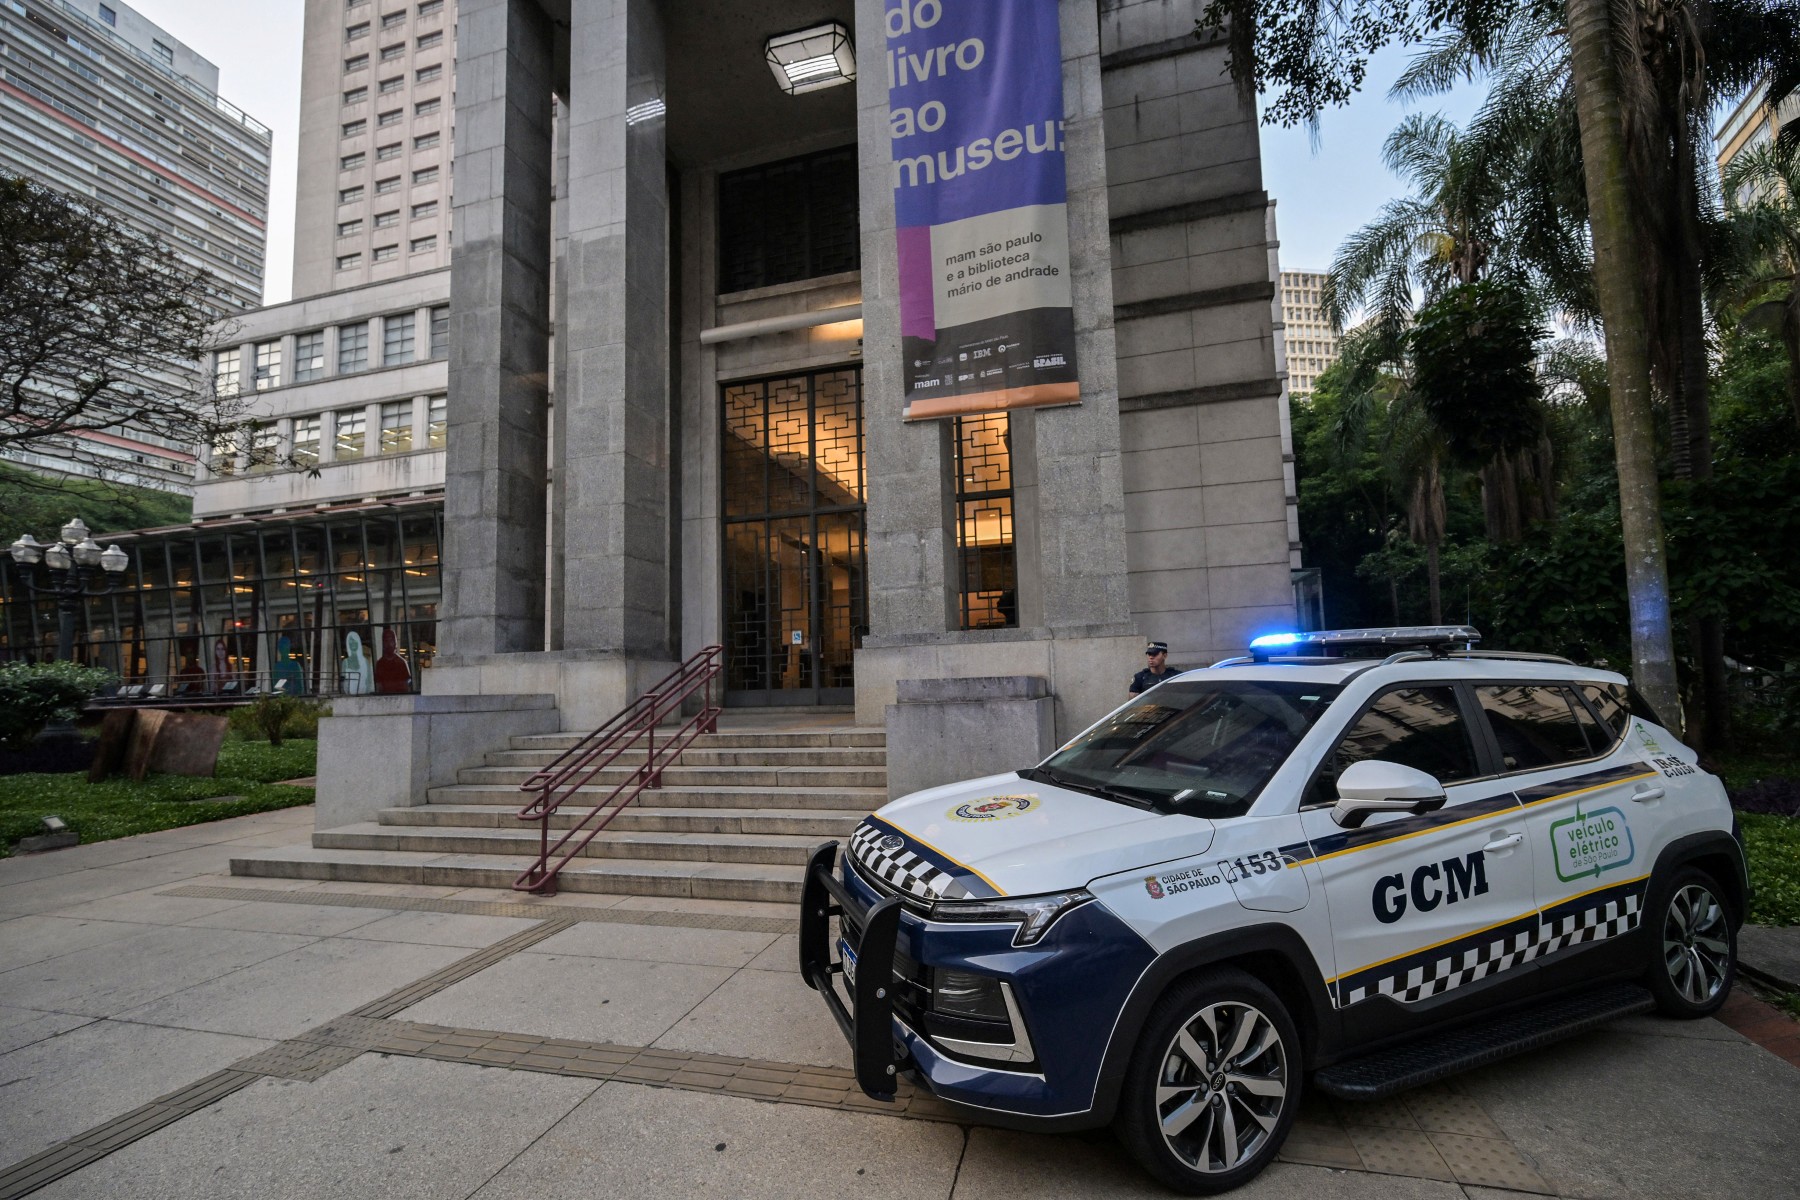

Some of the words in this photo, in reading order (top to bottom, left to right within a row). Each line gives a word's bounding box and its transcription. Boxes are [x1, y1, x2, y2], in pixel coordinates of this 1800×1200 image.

[885, 0, 942, 38] do
[886, 38, 985, 89] livro
[890, 100, 946, 139] ao
[945, 250, 976, 266] mam
[979, 243, 1002, 255] são
[1005, 232, 1042, 251] paulo
[946, 272, 954, 282] e
[957, 270, 965, 280] a
[968, 252, 1030, 276] biblioteca
[947, 281, 982, 298] mário
[985, 276, 1001, 288] de
[1005, 265, 1059, 283] andrade
[973, 348, 992, 359] IBM
[1033, 356, 1067, 368] BRASIL
[914, 379, 940, 389] mam
[1567, 817, 1614, 842] veículo
[1569, 835, 1619, 858] elétrico
[1573, 859, 1582, 868] de
[1598, 849, 1618, 861] Paulo
[1161, 871, 1192, 885] CIDADE
[1192, 868, 1204, 878] DE
[1234, 851, 1282, 879] 153
[1166, 882, 1188, 896] SÃO
[1188, 875, 1221, 892] PAULO
[1372, 850, 1489, 924] GCM
